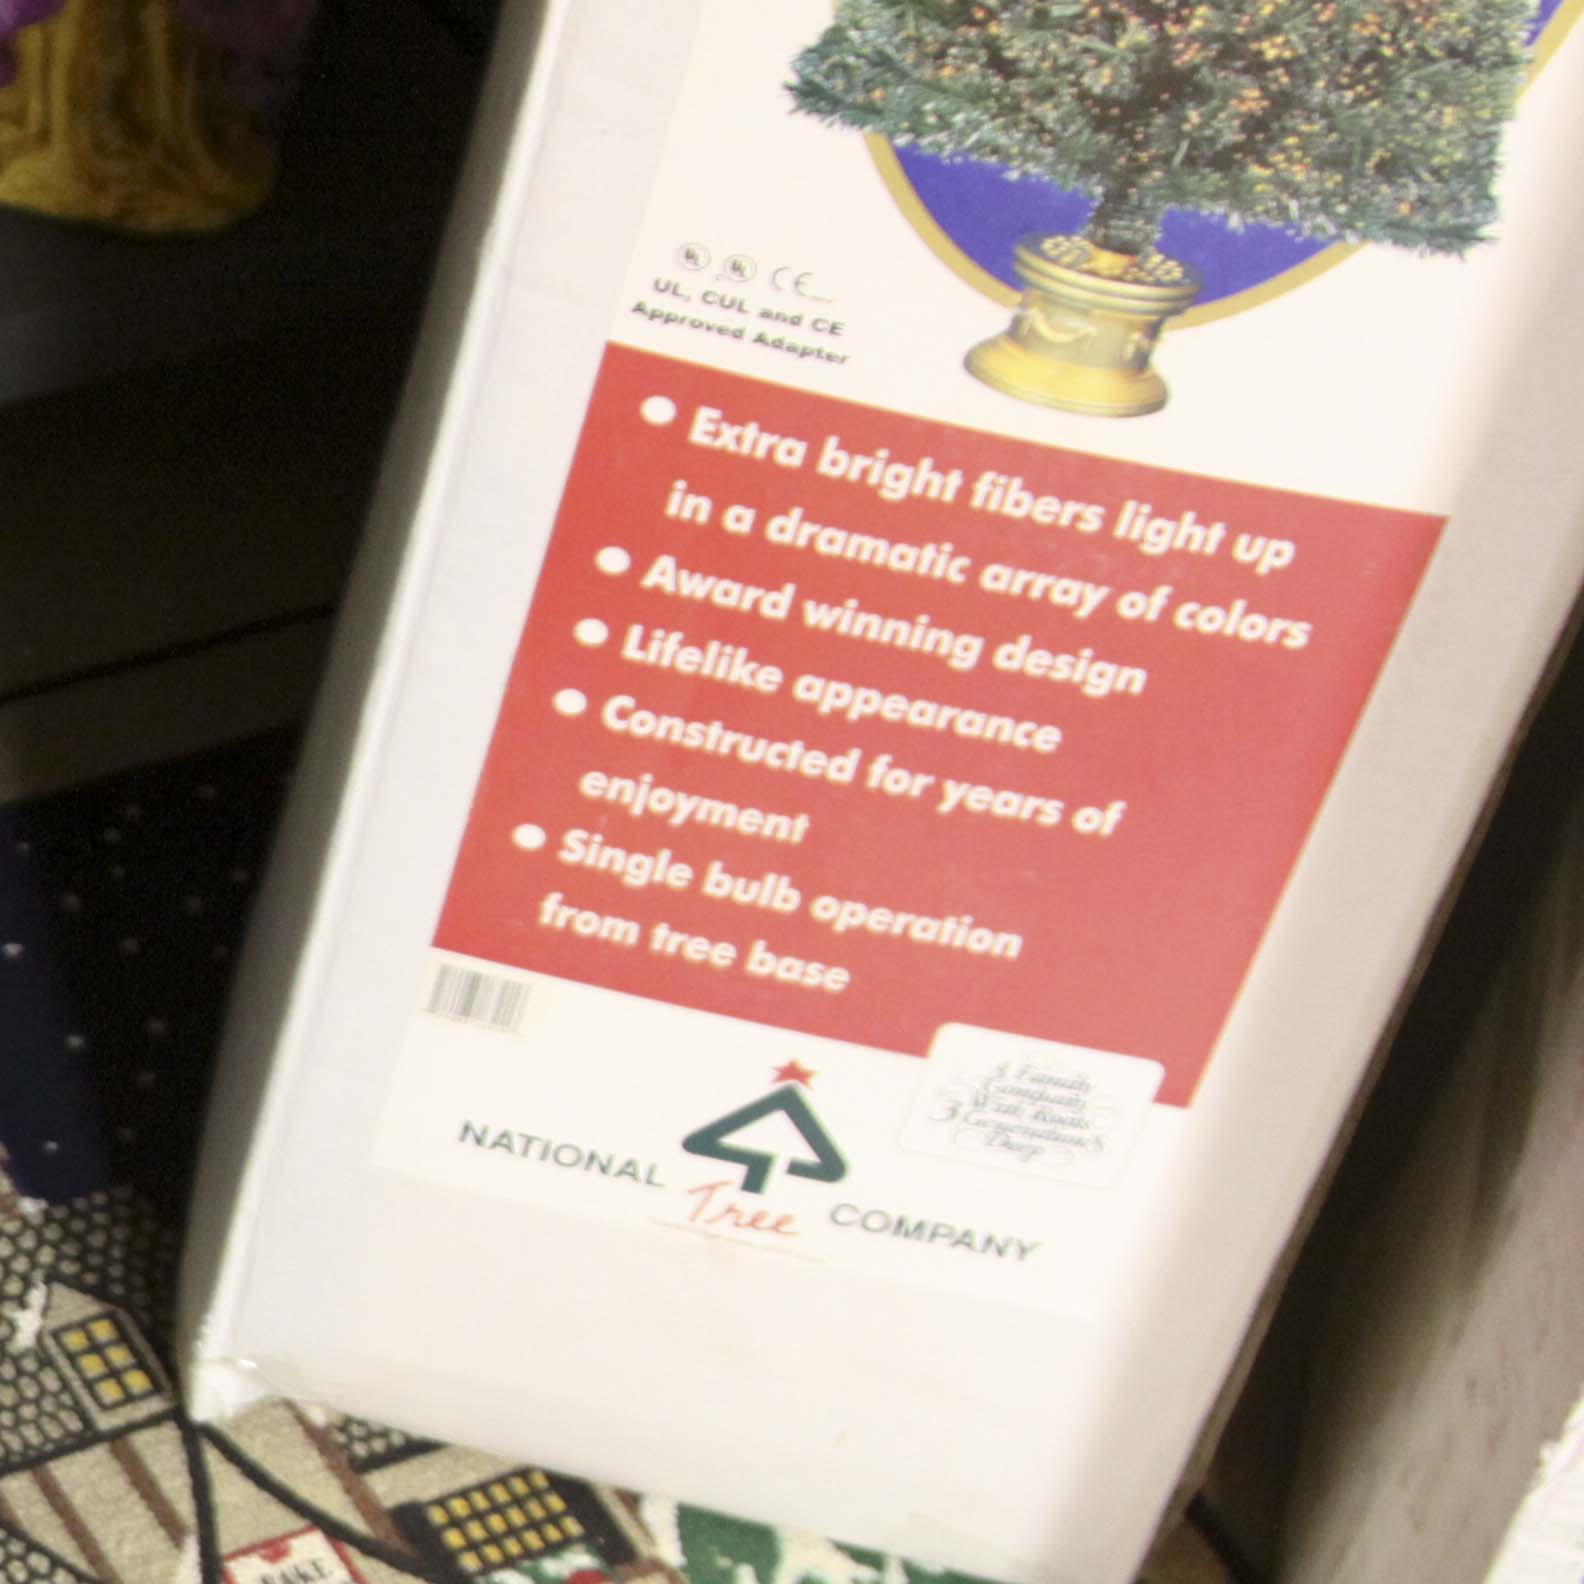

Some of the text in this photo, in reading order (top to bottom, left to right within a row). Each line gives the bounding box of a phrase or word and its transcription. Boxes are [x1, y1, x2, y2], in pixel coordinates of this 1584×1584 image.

[631, 299, 851, 365] Approved Adapter
[701, 289, 752, 314] CUL
[758, 307, 804, 328] and
[810, 316, 848, 336] CE
[689, 405, 1298, 576] Extra bright fibers light up
[641, 553, 1149, 698] Award winning design
[666, 478, 1314, 650] in a dramatic array of colors
[622, 623, 1064, 754] Lifelike appearance
[580, 770, 811, 844] enjoyment
[602, 693, 1128, 837] Constructed for years of
[540, 891, 852, 992] from tree base
[558, 827, 1025, 959] Single bulb operation
[458, 1120, 1041, 1262] NATIONAL Tree COMPANY
